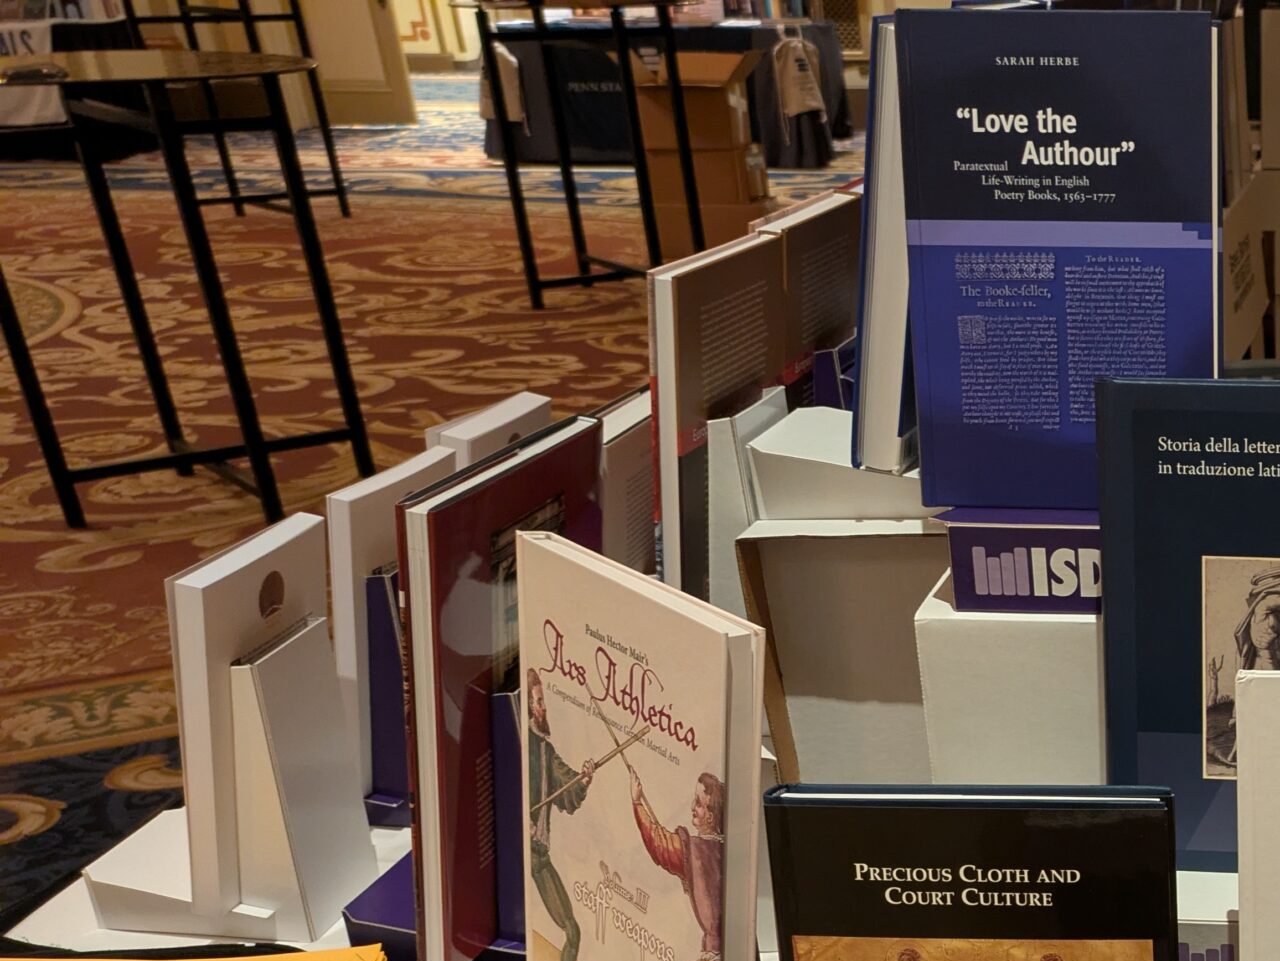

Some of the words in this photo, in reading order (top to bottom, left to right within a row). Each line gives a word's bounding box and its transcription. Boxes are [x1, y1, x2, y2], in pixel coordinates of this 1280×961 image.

[995, 57, 1034, 66] SARAH
[1040, 57, 1080, 66] HERBE
[1037, 108, 1077, 133] the
[953, 161, 1008, 171] Paratextual
[982, 176, 1039, 188] Life-Writing
[1042, 177, 1052, 186] in
[1055, 176, 1089, 188] English
[994, 190, 1025, 201] Poetry
[1028, 190, 1060, 201] Books,
[1158, 437, 1201, 452] Storia
[1205, 437, 1240, 453] della
[1158, 461, 1172, 474] in
[1176, 461, 1254, 477] traduzione
[585, 623, 606, 644] Paulus
[607, 636, 628, 655] Hector
[539, 619, 587, 686] Ars
[591, 647, 698, 751] Athletica
